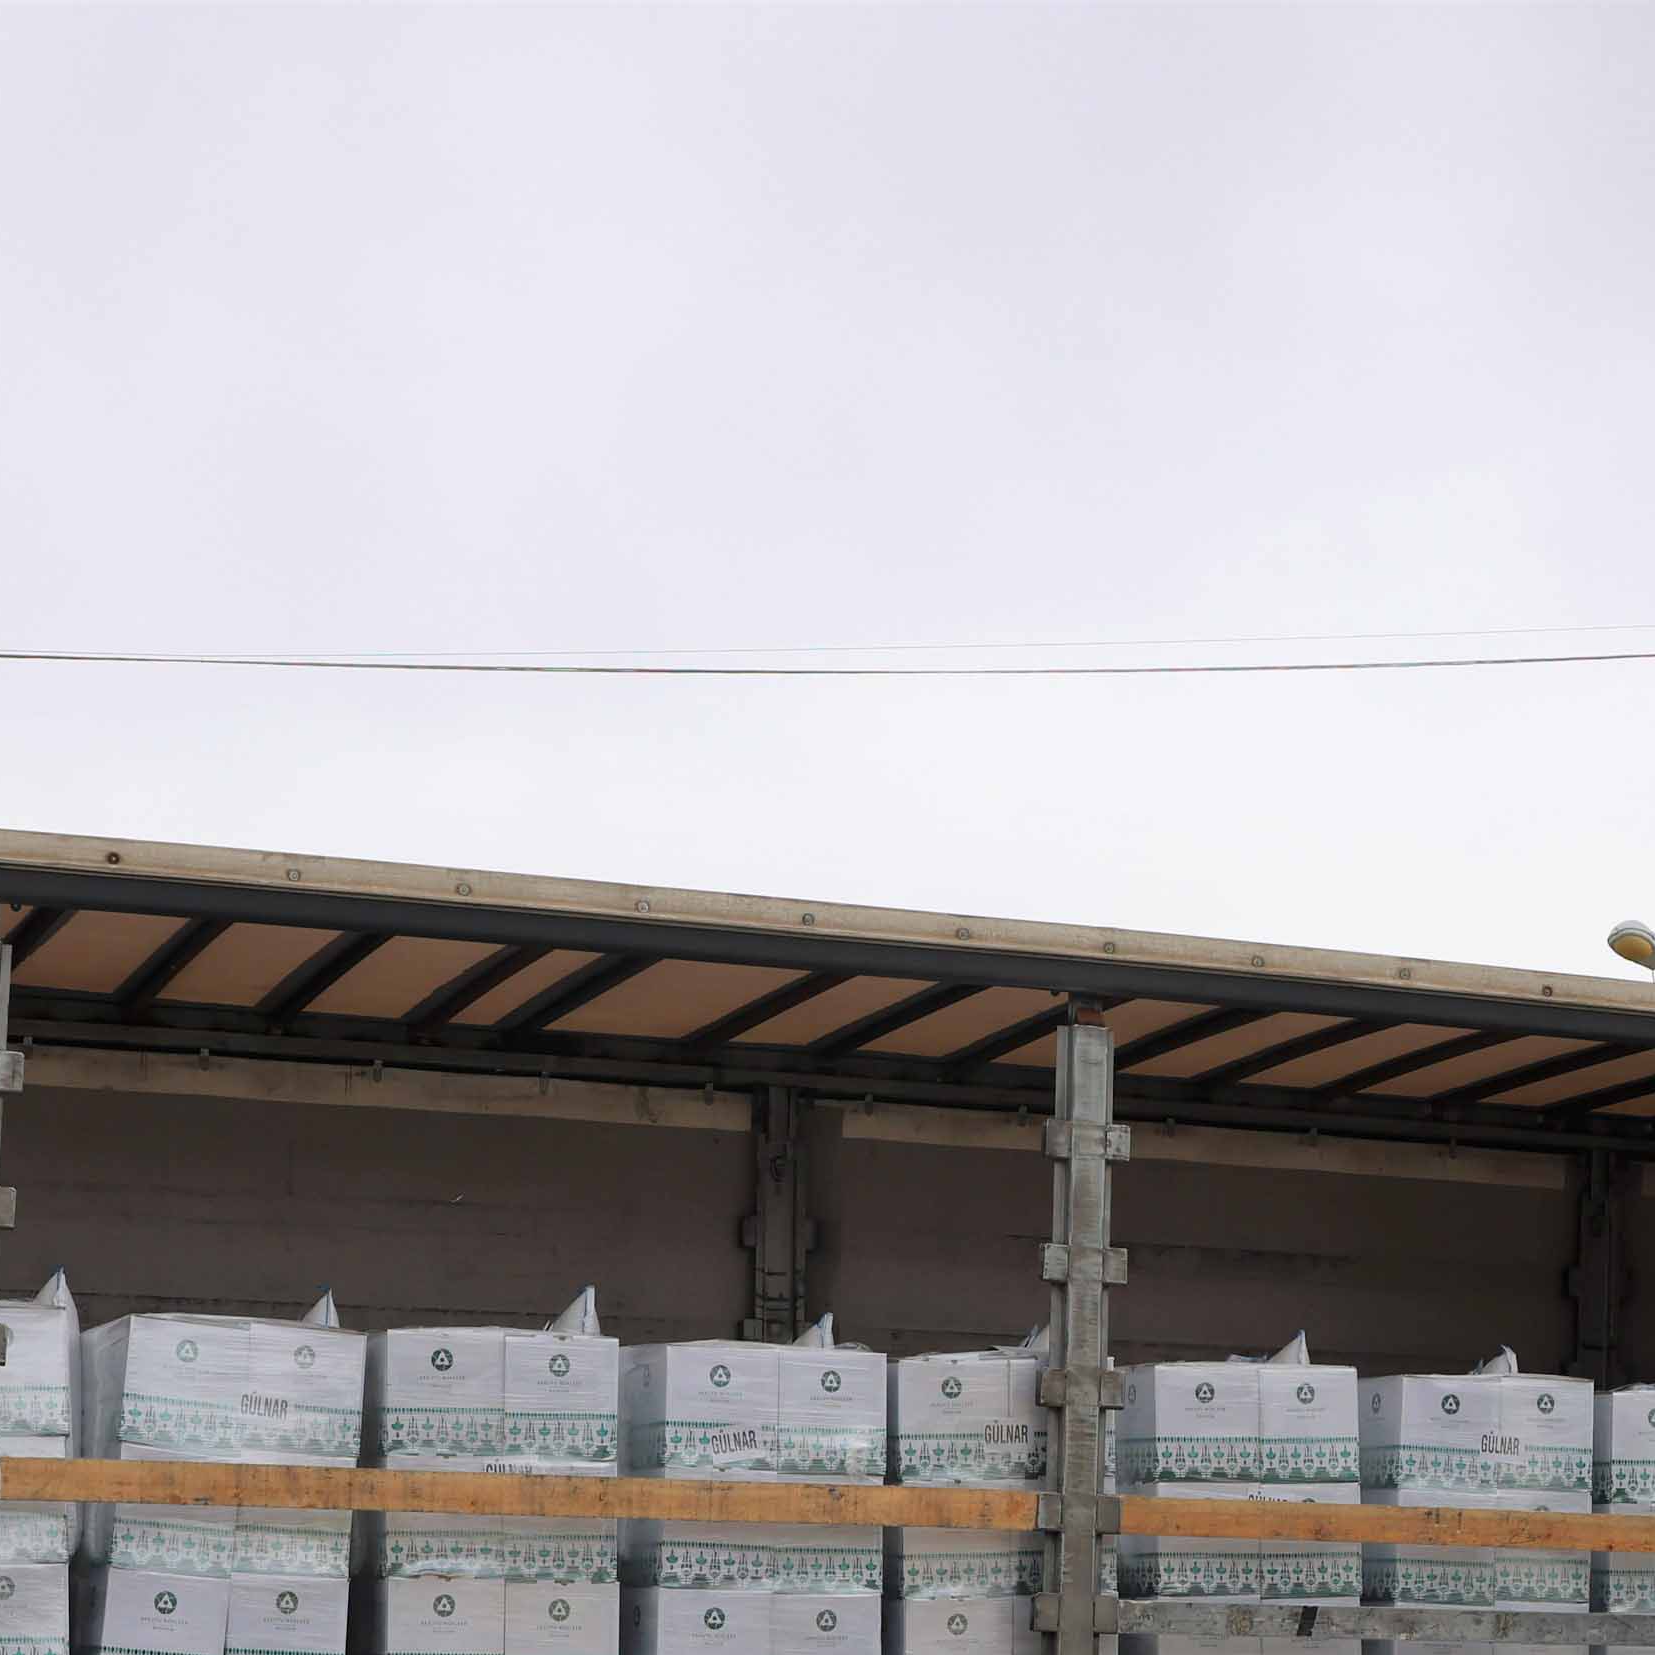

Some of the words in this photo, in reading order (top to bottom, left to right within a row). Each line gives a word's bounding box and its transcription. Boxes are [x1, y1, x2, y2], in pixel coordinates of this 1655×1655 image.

[240, 1391, 288, 1420] GÜLNAR
[712, 1429, 757, 1454] GÜLNAR
[985, 1419, 1028, 1444] GÜLNAR
[1481, 1430, 1519, 1456] GÜLNAR
